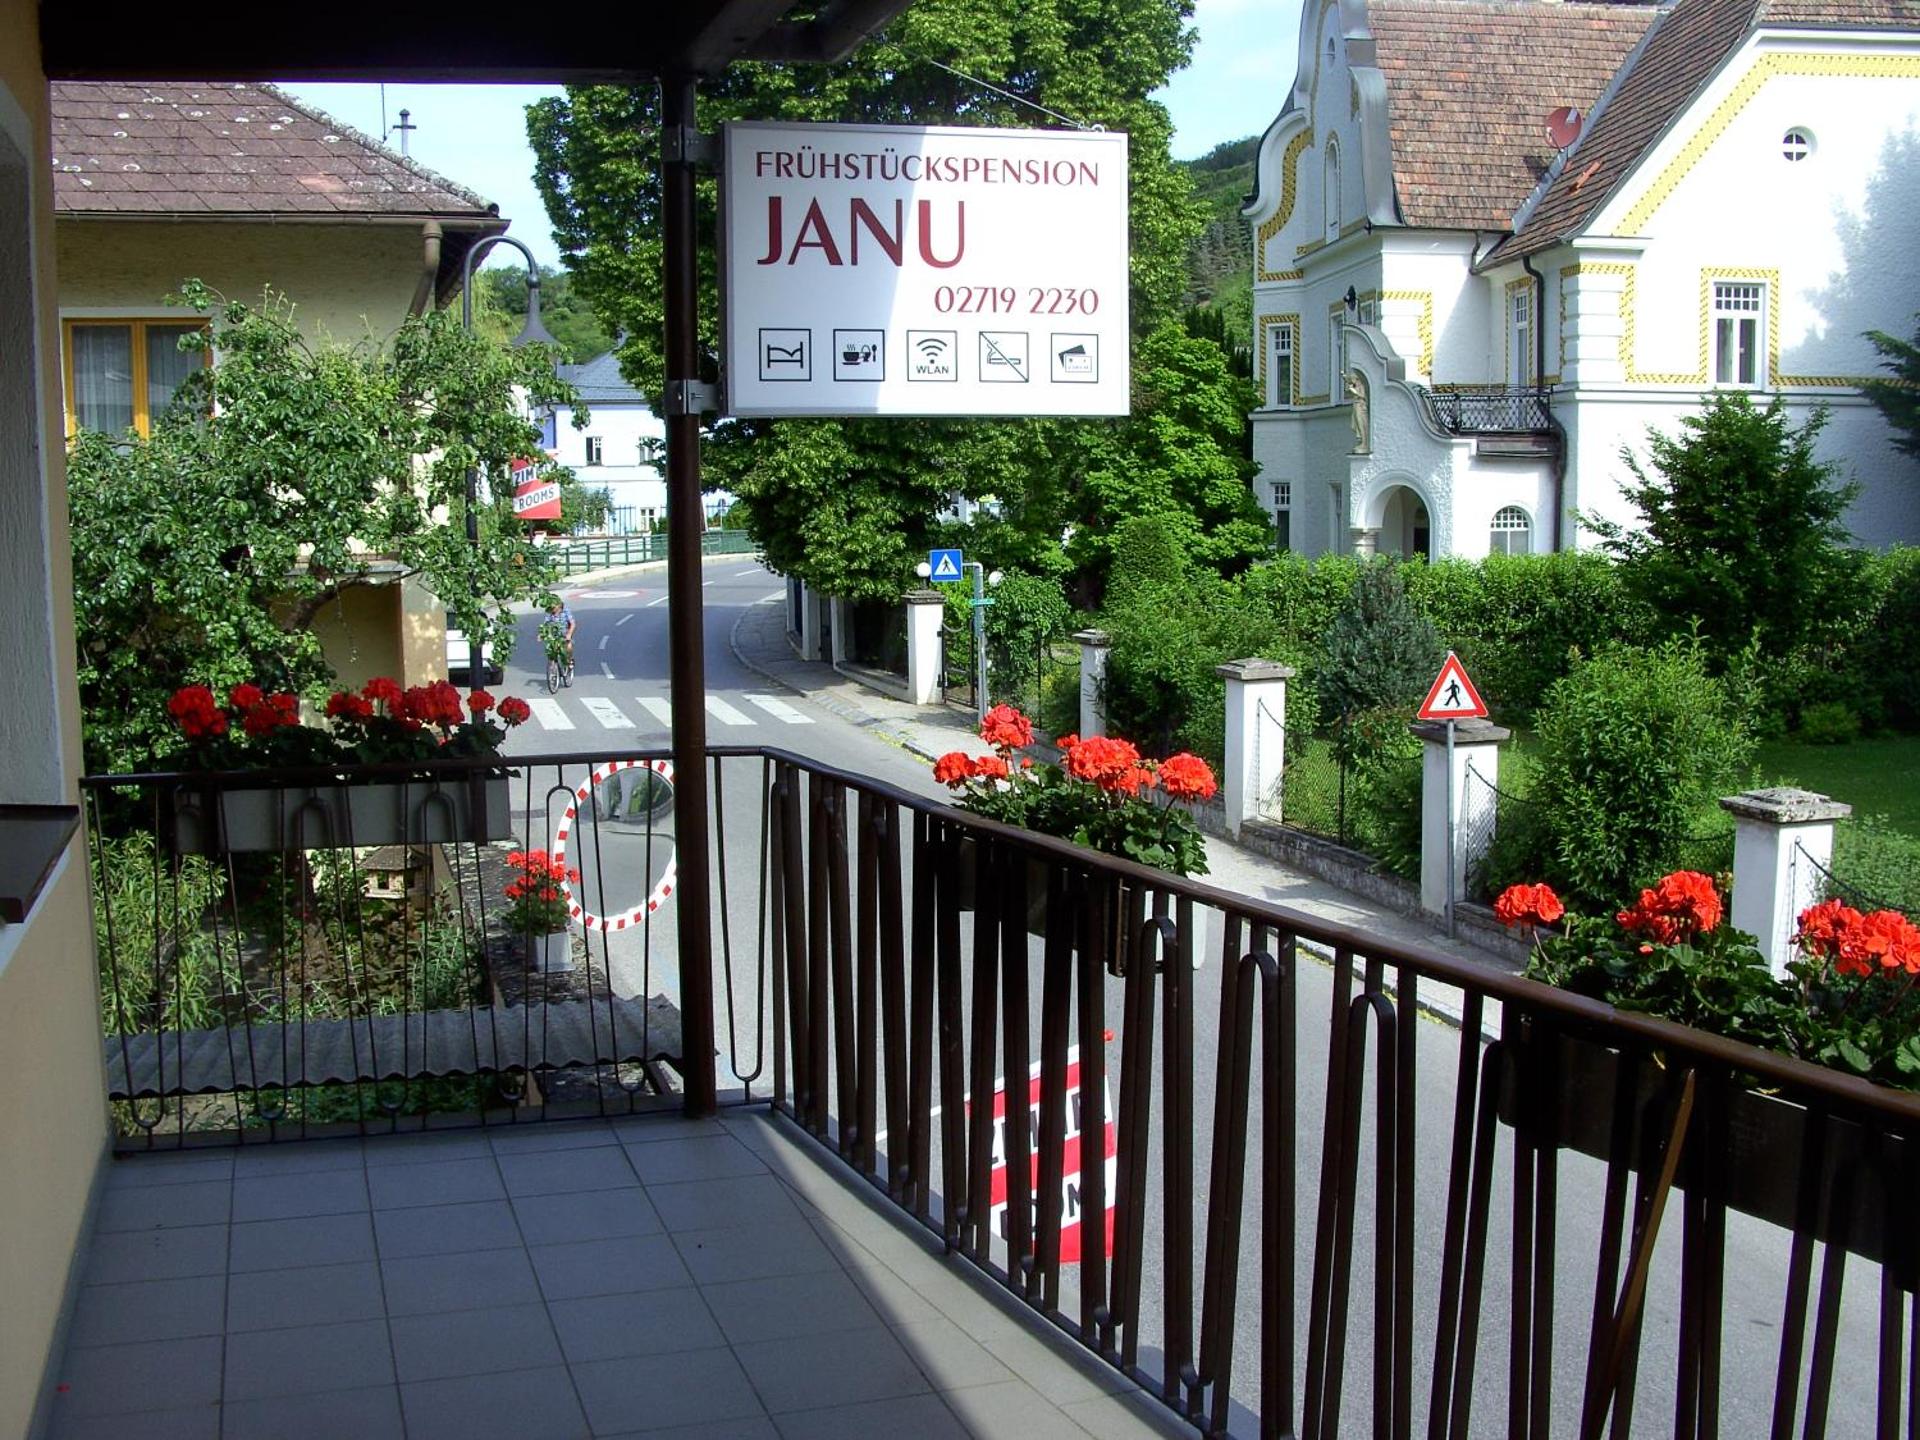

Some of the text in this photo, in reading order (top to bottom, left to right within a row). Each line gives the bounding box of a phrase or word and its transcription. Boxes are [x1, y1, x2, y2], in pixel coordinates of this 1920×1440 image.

[755, 145, 1099, 187] FRÜHSTÜCKSPENSION
[757, 195, 965, 268] JANU
[934, 286, 1099, 315] 02719 2230
[916, 365, 949, 375] WLAN
[519, 487, 554, 510] ROOMS
